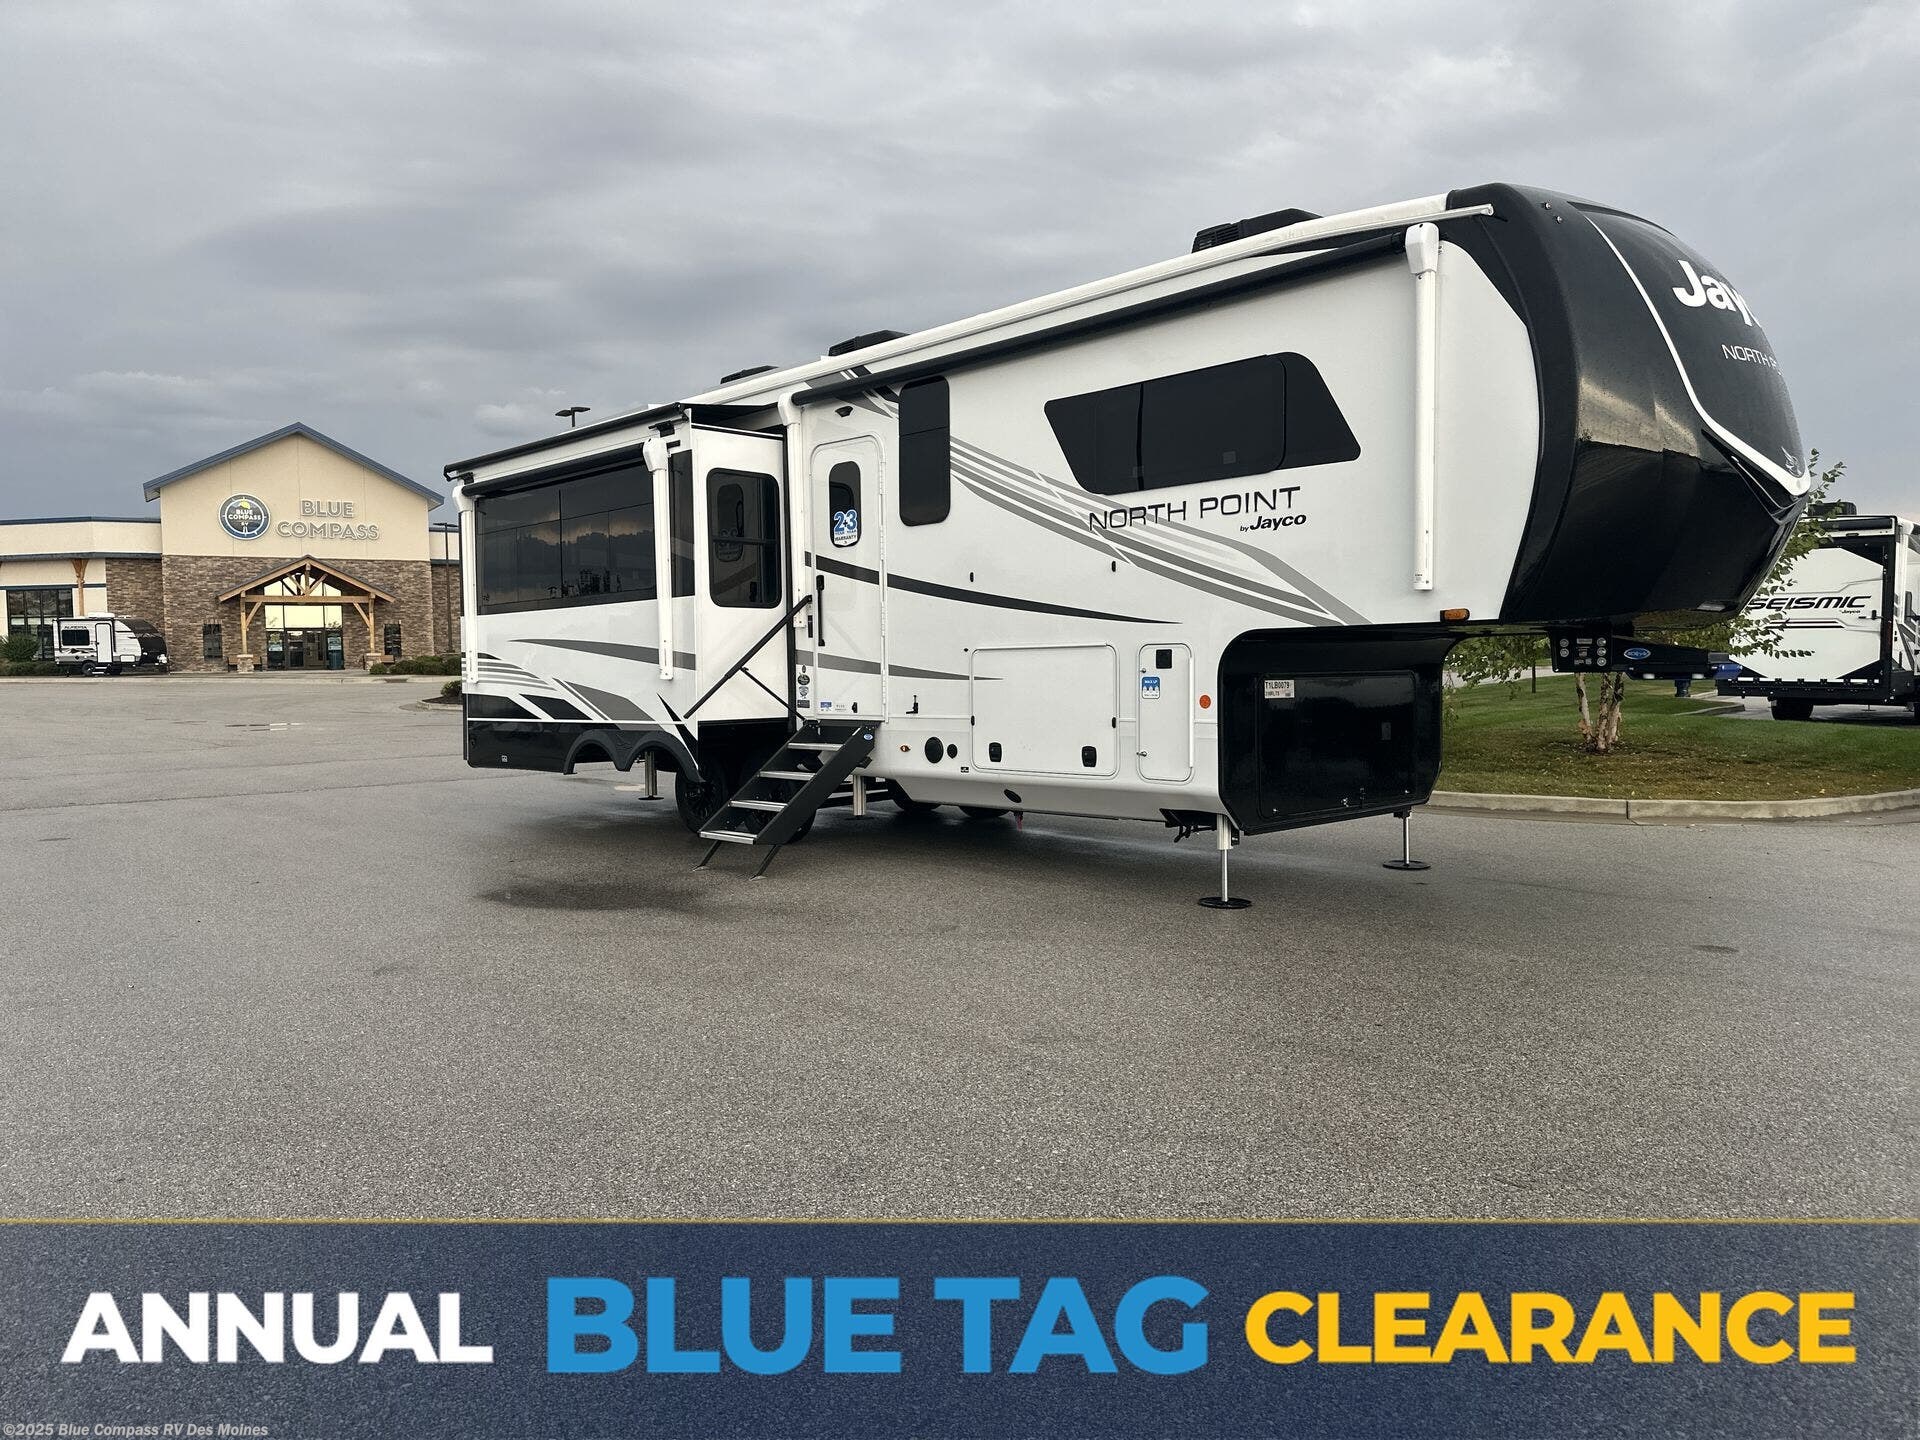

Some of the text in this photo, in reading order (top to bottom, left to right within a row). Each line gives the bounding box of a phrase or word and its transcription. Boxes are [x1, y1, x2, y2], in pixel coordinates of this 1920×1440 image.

[1672, 259, 1762, 327] Jay
[1721, 344, 1771, 368] NORTH
[301, 499, 354, 518] BLUE
[1089, 486, 1301, 531] NORTH POINT
[276, 521, 379, 540] COMPASS
[1239, 515, 1307, 533] by Jayco
[1748, 595, 1872, 610] SEISMIC
